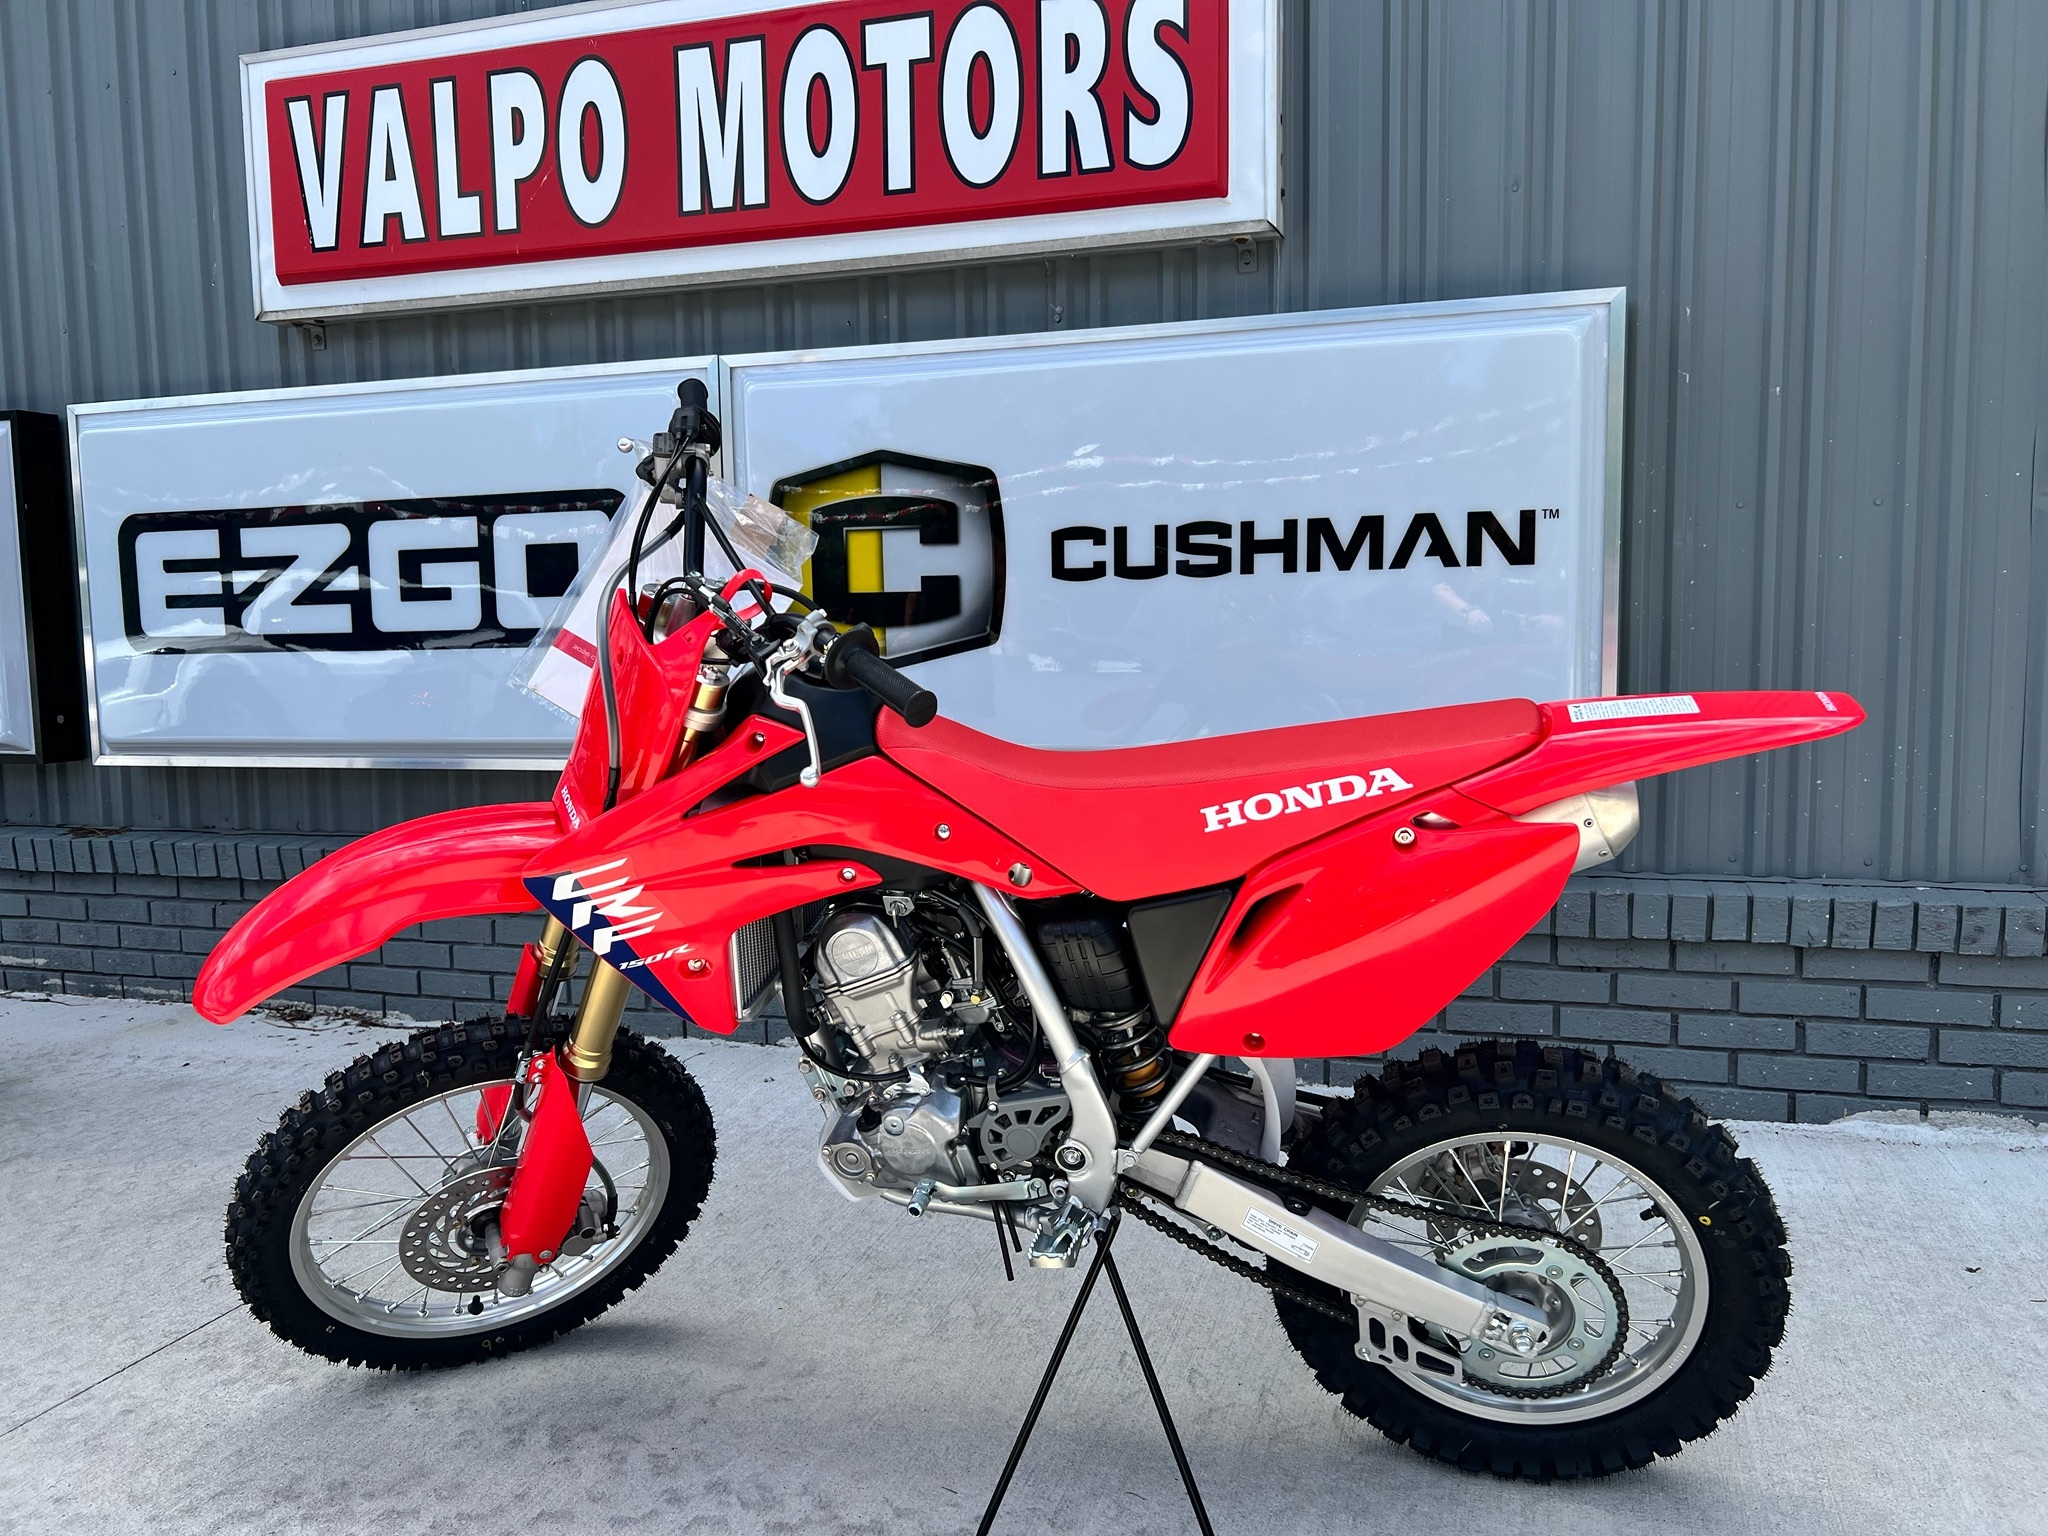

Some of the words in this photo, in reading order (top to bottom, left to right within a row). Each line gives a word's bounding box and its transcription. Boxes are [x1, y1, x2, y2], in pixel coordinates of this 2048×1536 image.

[285, 54, 627, 254] VALPO
[674, 0, 1194, 218] MOTORS
[1050, 508, 1538, 583] CUSHMAN
[573, 644, 590, 657] 2026
[561, 784, 580, 830] HONDA
[1200, 767, 1414, 833] HONDA
[551, 856, 664, 956] CRF
[618, 943, 695, 971] 150R
